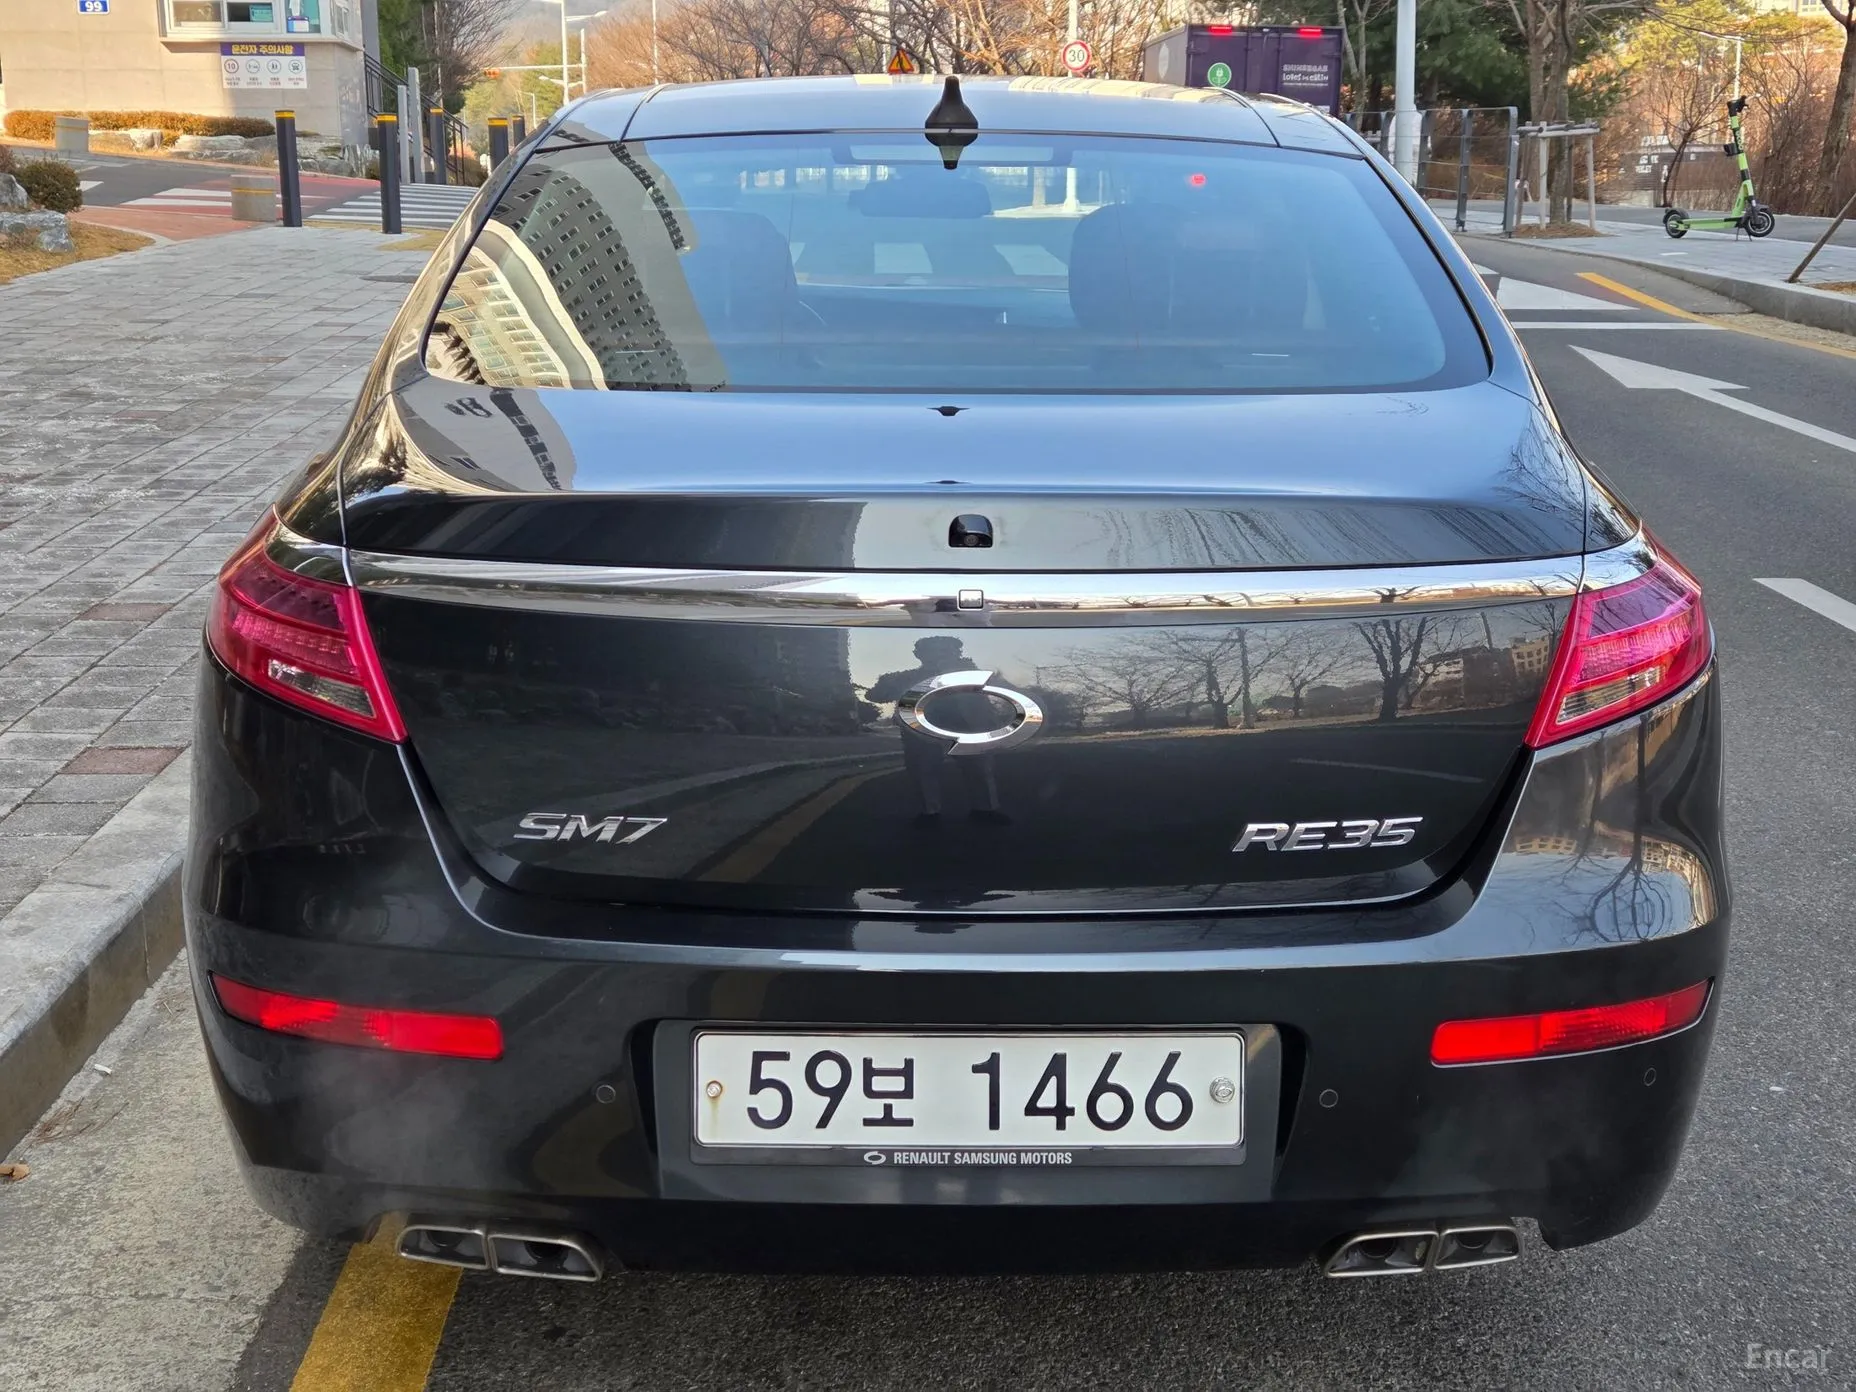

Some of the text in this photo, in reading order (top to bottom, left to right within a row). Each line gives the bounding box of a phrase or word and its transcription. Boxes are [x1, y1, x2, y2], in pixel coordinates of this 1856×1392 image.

[85, 1, 103, 12] 99
[1069, 49, 1085, 62] 30
[513, 812, 668, 844] SM7
[1232, 816, 1424, 852] RE35
[746, 1050, 1194, 1131] 59보 1466
[893, 1152, 1073, 1164] RENAULT SAMSUNG MOTORS
